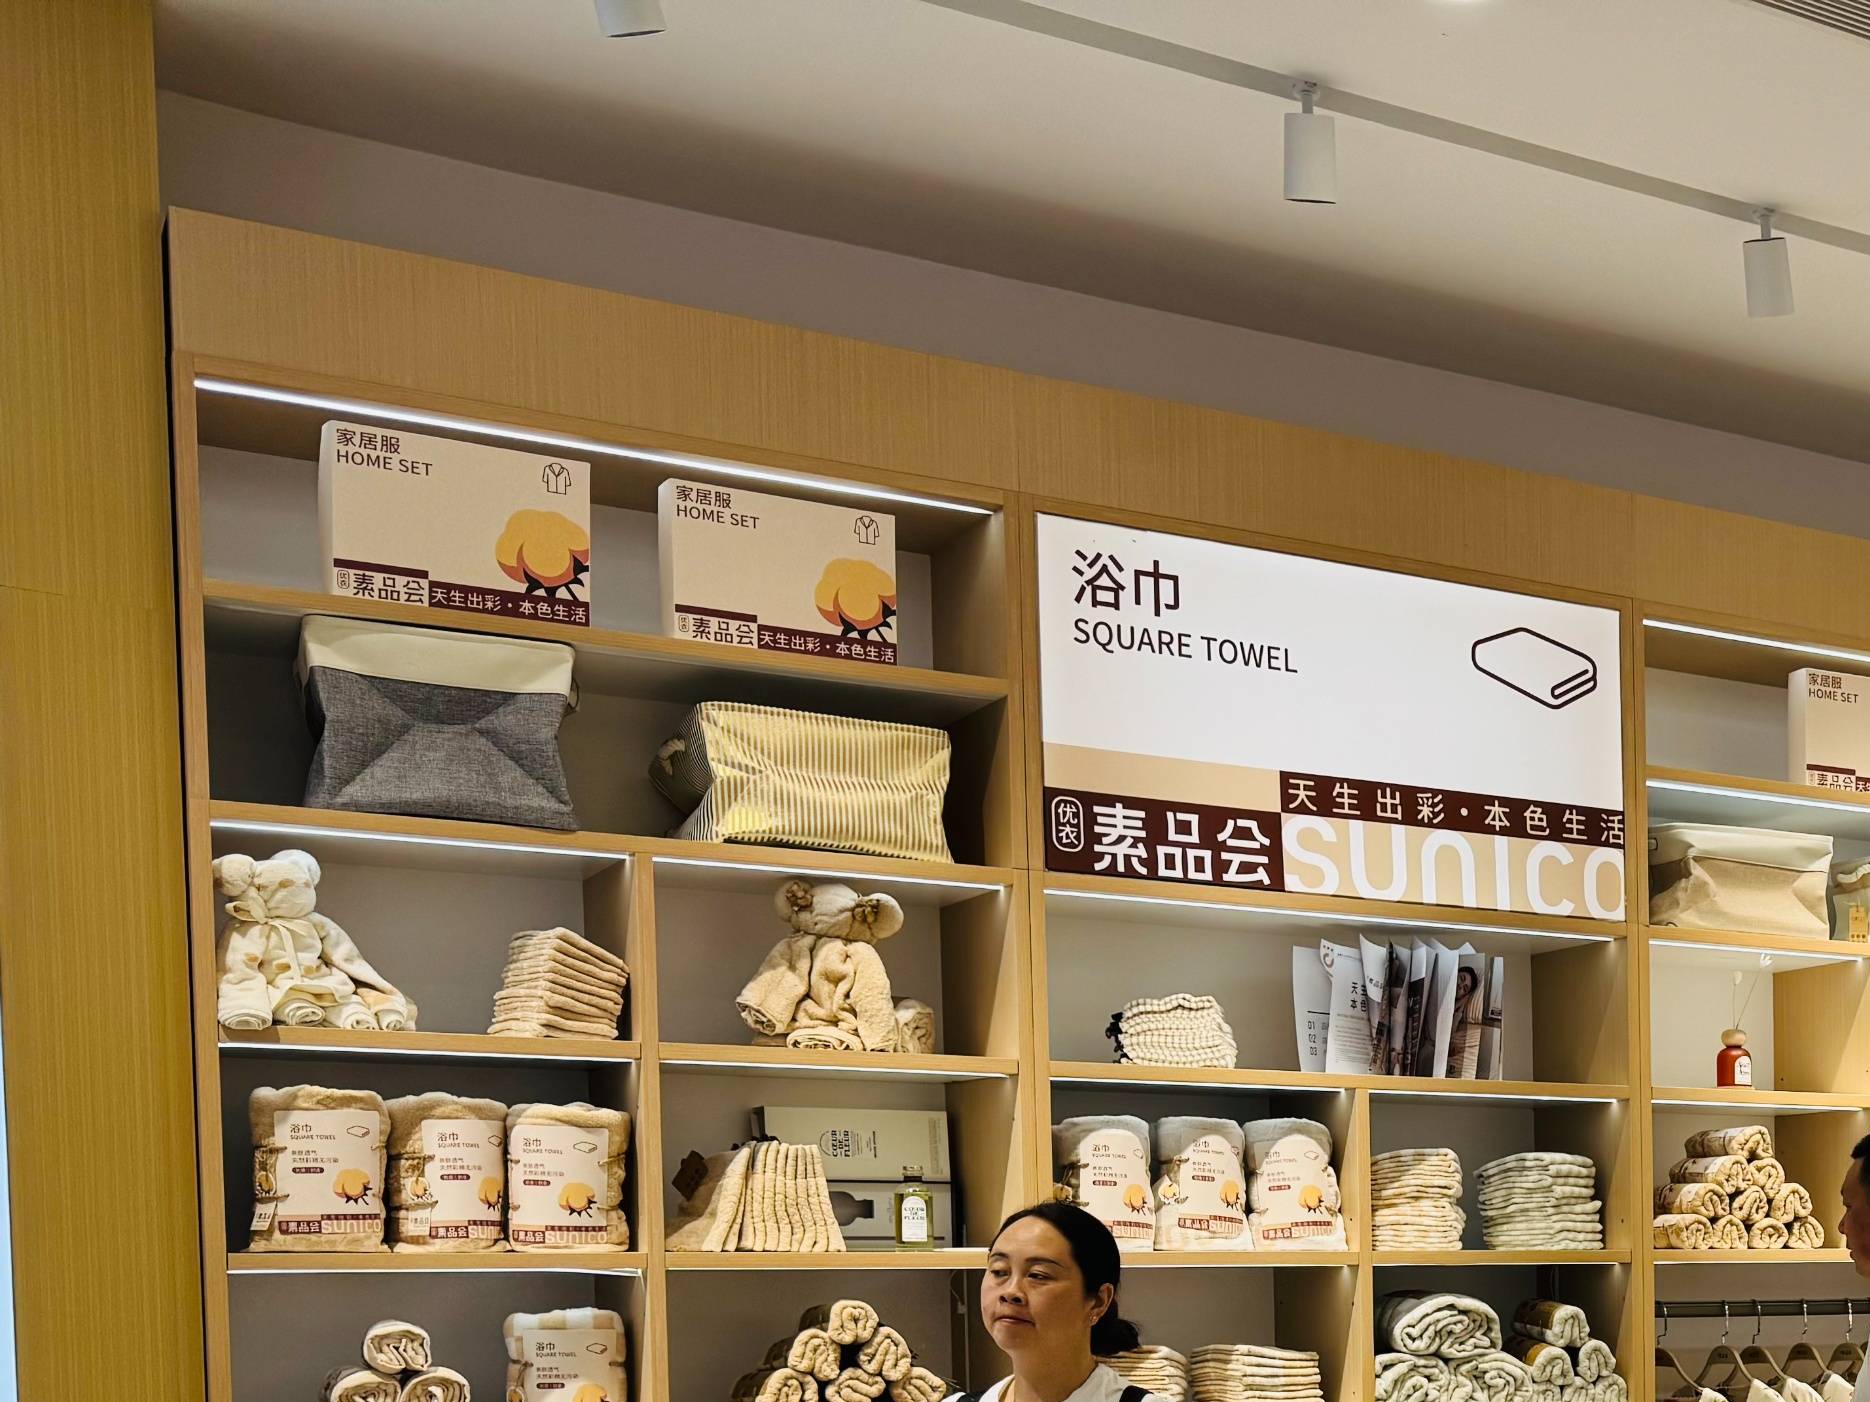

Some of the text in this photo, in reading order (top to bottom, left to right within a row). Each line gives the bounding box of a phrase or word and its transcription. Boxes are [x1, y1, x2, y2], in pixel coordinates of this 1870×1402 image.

[335, 427, 402, 456] 家居服
[336, 448, 433, 478] HOME SET
[676, 484, 733, 510] 家居服
[676, 505, 760, 530] HOME SET
[352, 570, 427, 606] 素品会
[1071, 548, 1181, 618] 浴巾
[691, 615, 756, 647] 素品会
[1072, 617, 1299, 674] SQUARE TOWEL
[1808, 672, 1842, 690] 家居服
[1808, 689, 1859, 703] HOME SET
[1092, 802, 1272, 887] 素品会
[289, 1123, 312, 1133] 浴巾
[437, 1131, 460, 1142] 浴巾
[522, 1137, 542, 1147] 浴巾
[535, 1341, 556, 1352] 浴巾
